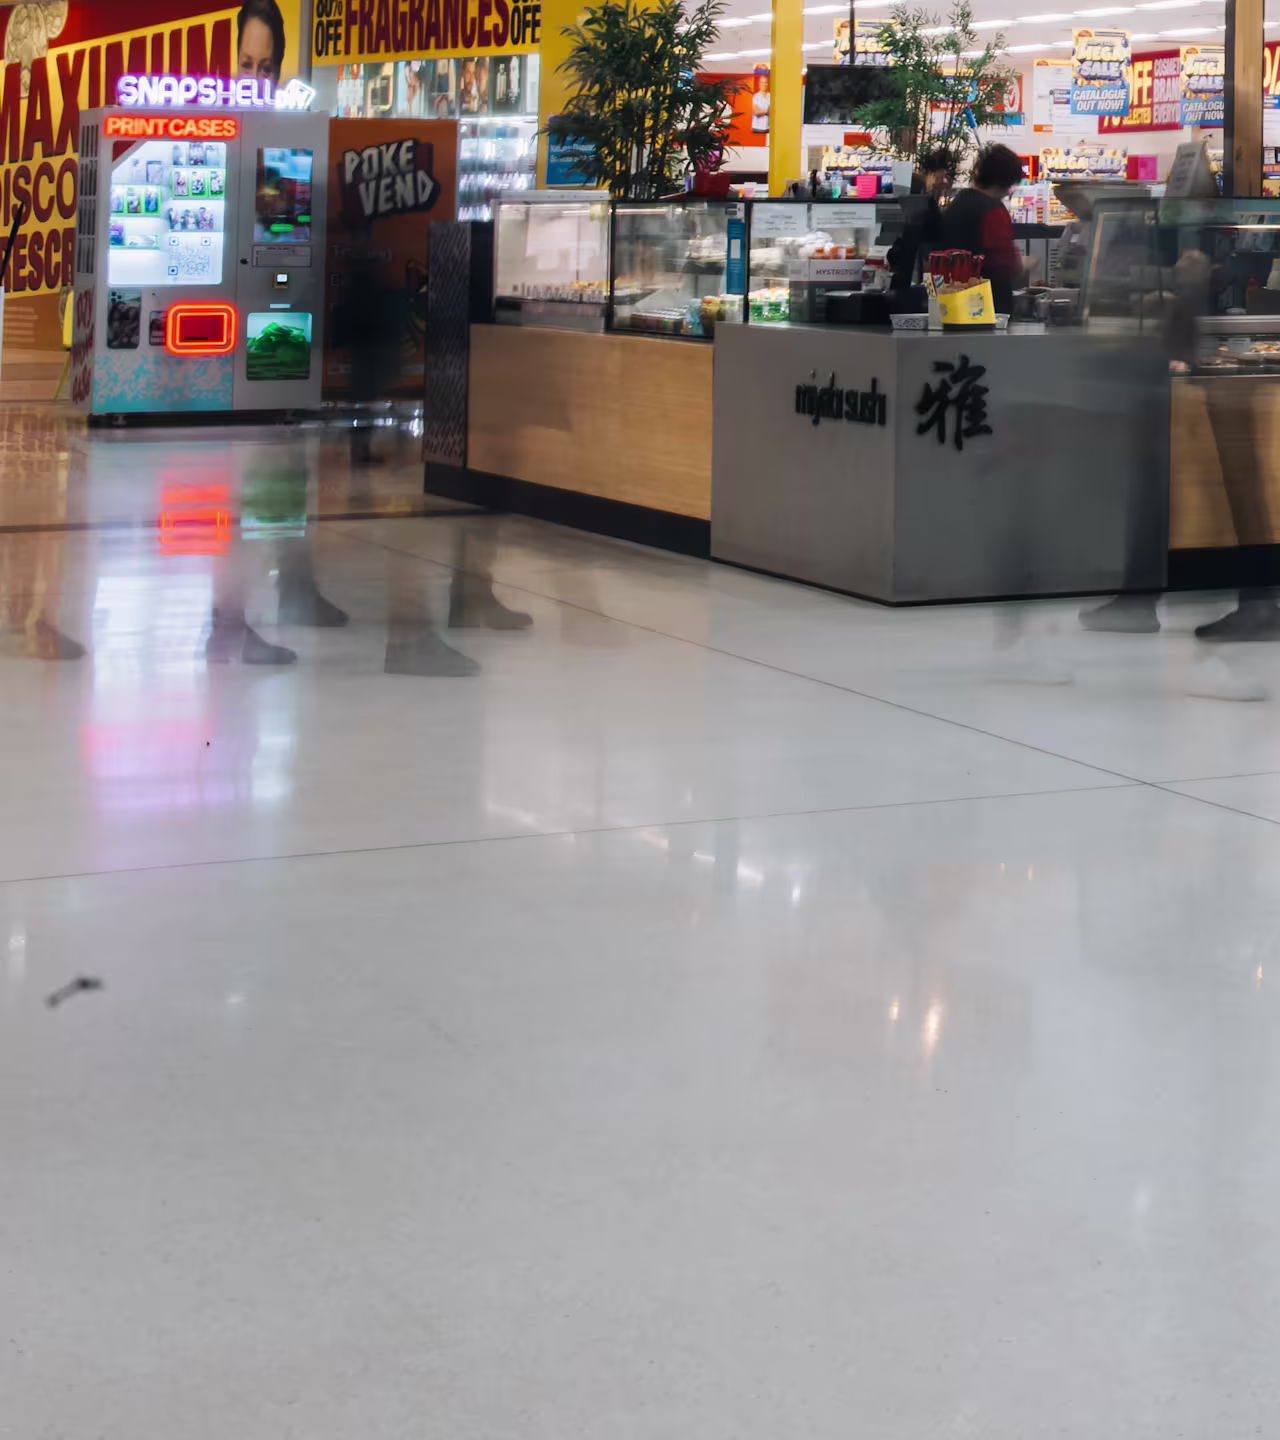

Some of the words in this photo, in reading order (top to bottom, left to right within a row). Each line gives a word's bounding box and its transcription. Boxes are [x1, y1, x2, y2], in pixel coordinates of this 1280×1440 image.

[315, 19, 342, 57] OFF
[510, 4, 541, 45] OFF
[118, 74, 277, 106] SNAPSHELL
[1073, 89, 1127, 101] CATALOGUE
[1076, 100, 1097, 111] OUT
[1098, 99, 1124, 111] NOW!
[106, 117, 168, 137] PRINT
[169, 117, 237, 138] CASES
[344, 139, 415, 185] POKE
[0, 158, 78, 227] ISCO
[358, 169, 434, 217] VEND
